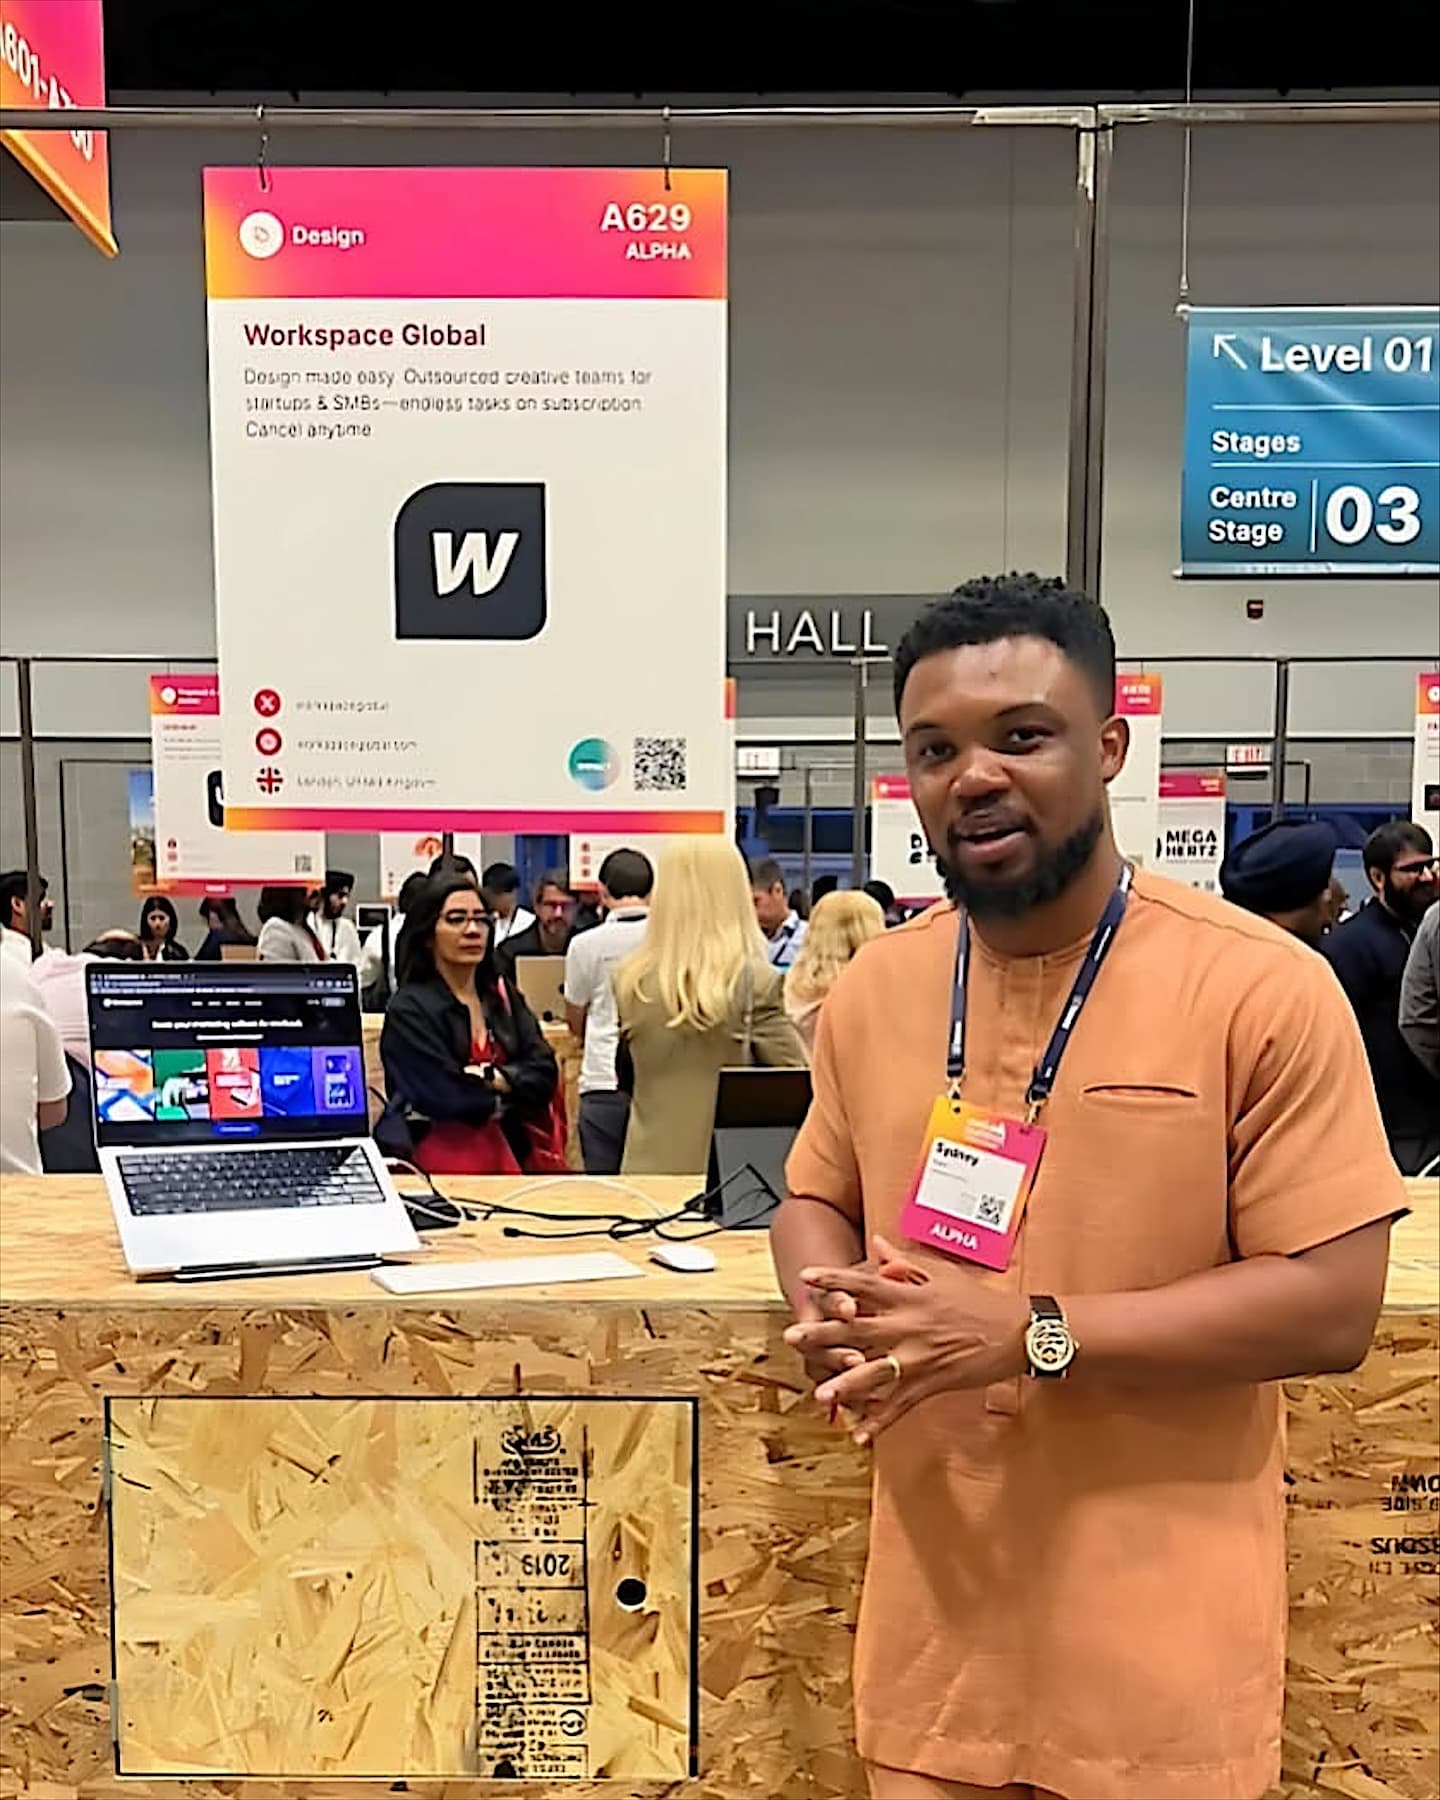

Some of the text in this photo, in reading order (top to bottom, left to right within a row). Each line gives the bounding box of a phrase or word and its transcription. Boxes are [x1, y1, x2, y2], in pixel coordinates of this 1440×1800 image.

[600, 203, 692, 232] A629
[291, 225, 365, 249] Design
[625, 242, 692, 260] ALPHA
[244, 324, 486, 351] Workspace Global
[1260, 336, 1433, 373] Level 01
[244, 368, 301, 388] Design
[305, 370, 352, 385] made
[404, 368, 500, 385] Outsourced
[505, 369, 570, 385] creative
[575, 370, 625, 385] teams
[631, 369, 652, 385] for
[246, 396, 312, 413] startups
[317, 395, 328, 410] &
[468, 397, 511, 412] tasks
[516, 397, 538, 411] on
[246, 420, 303, 438] Cancel
[1211, 431, 1301, 459] Stages
[1210, 486, 1298, 509] Centre
[1325, 484, 1422, 545] 03
[1208, 519, 1284, 547] Stage
[432, 531, 520, 596] W
[747, 610, 889, 652] HALL
[1166, 830, 1217, 844] MEGA
